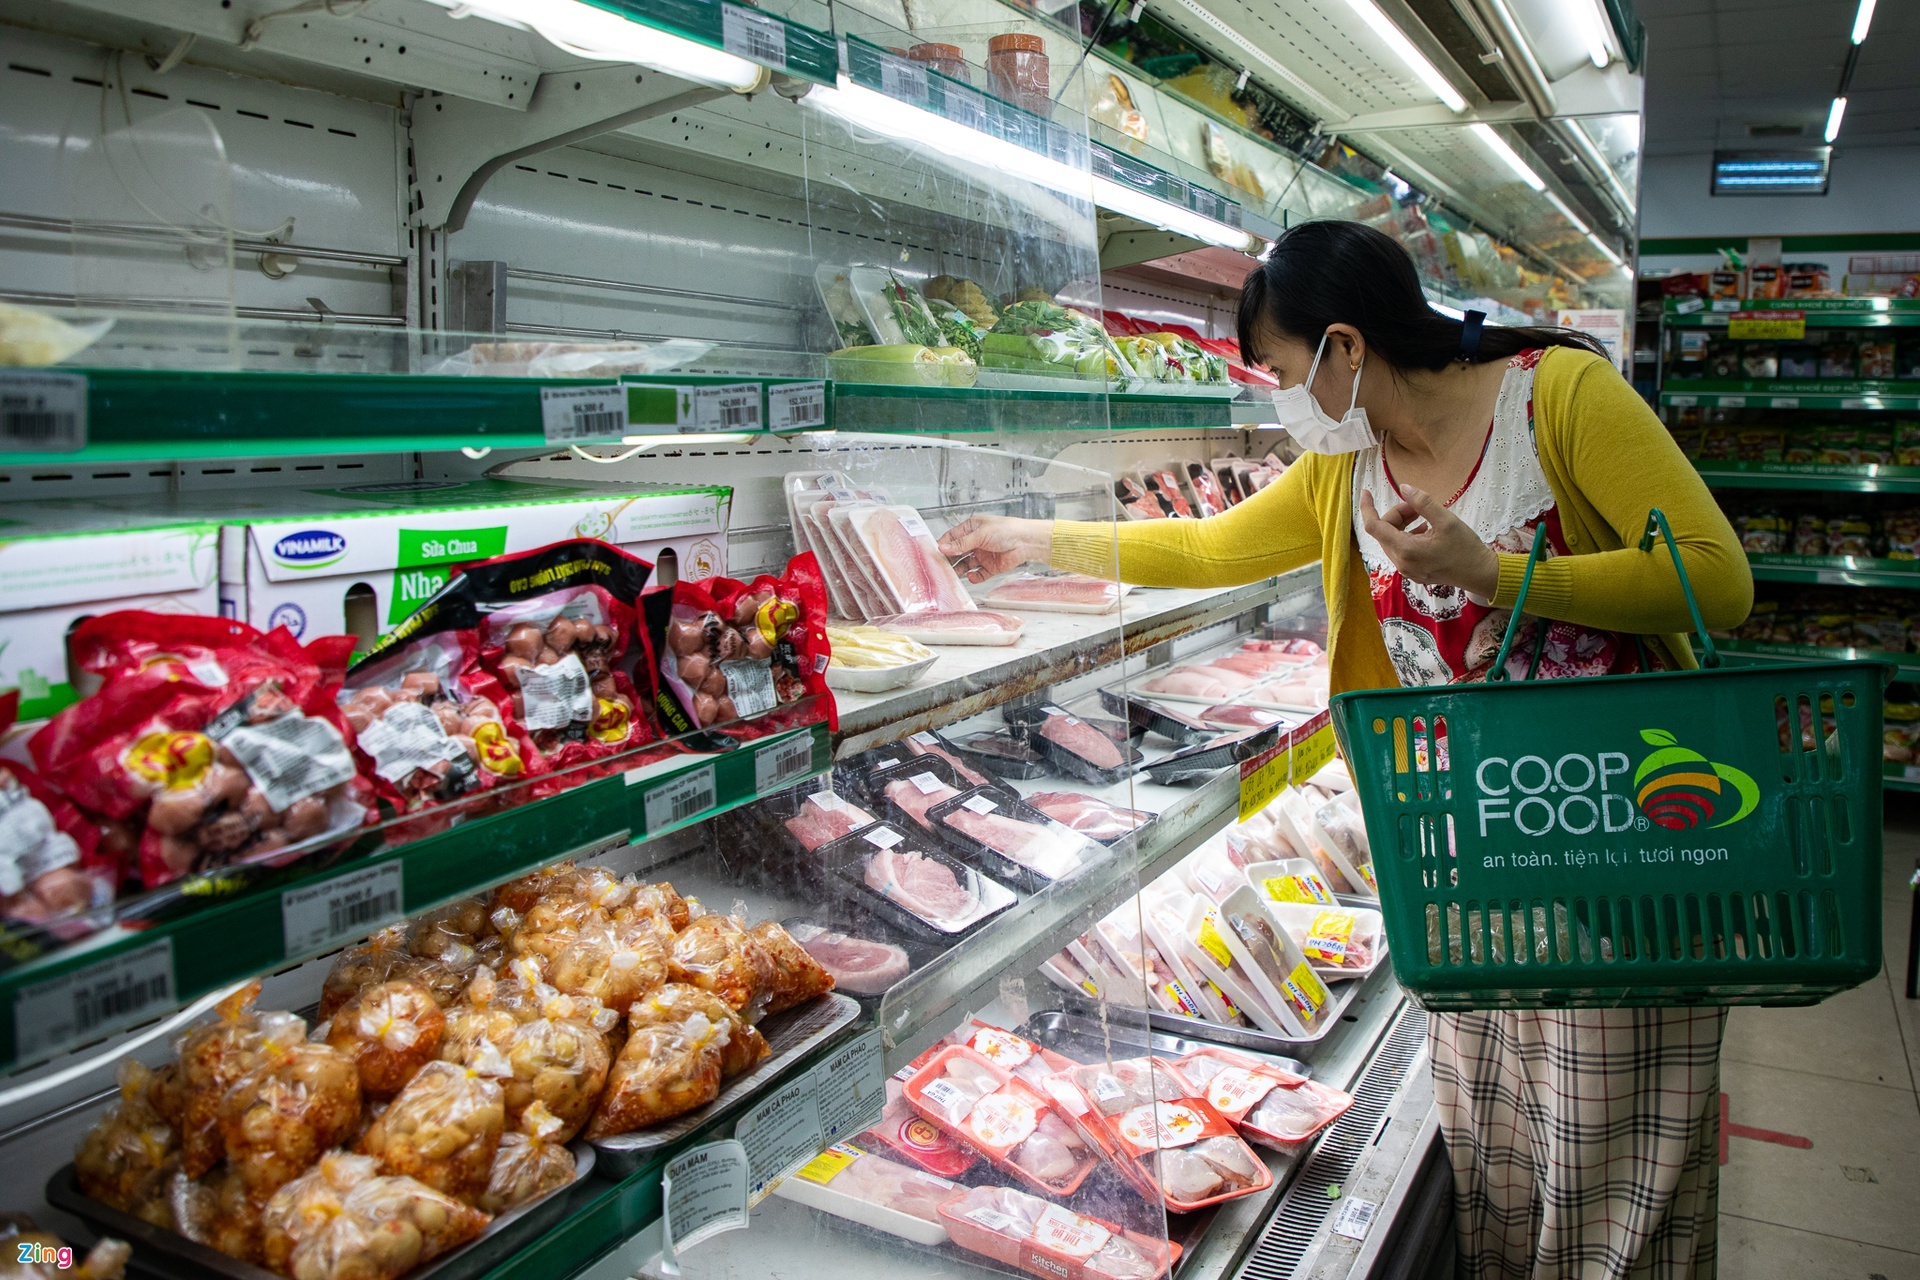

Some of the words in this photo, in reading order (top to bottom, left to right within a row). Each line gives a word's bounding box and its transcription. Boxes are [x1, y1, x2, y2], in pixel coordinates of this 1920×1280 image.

[277, 536, 343, 556] VINAMILK
[422, 540, 445, 558] Sữa
[447, 539, 478, 555] Chua
[671, 714, 688, 732] CAO
[1475, 752, 1631, 796] CO.OP
[1483, 855, 1505, 868] an
[1564, 849, 1600, 869] tiện
[1639, 848, 1675, 864] tươi
[1681, 847, 1729, 866] ngon
[781, 1087, 800, 1105] PHÁO
[914, 1125, 934, 1140] CP
[1031, 1252, 1068, 1273] Kitchen
